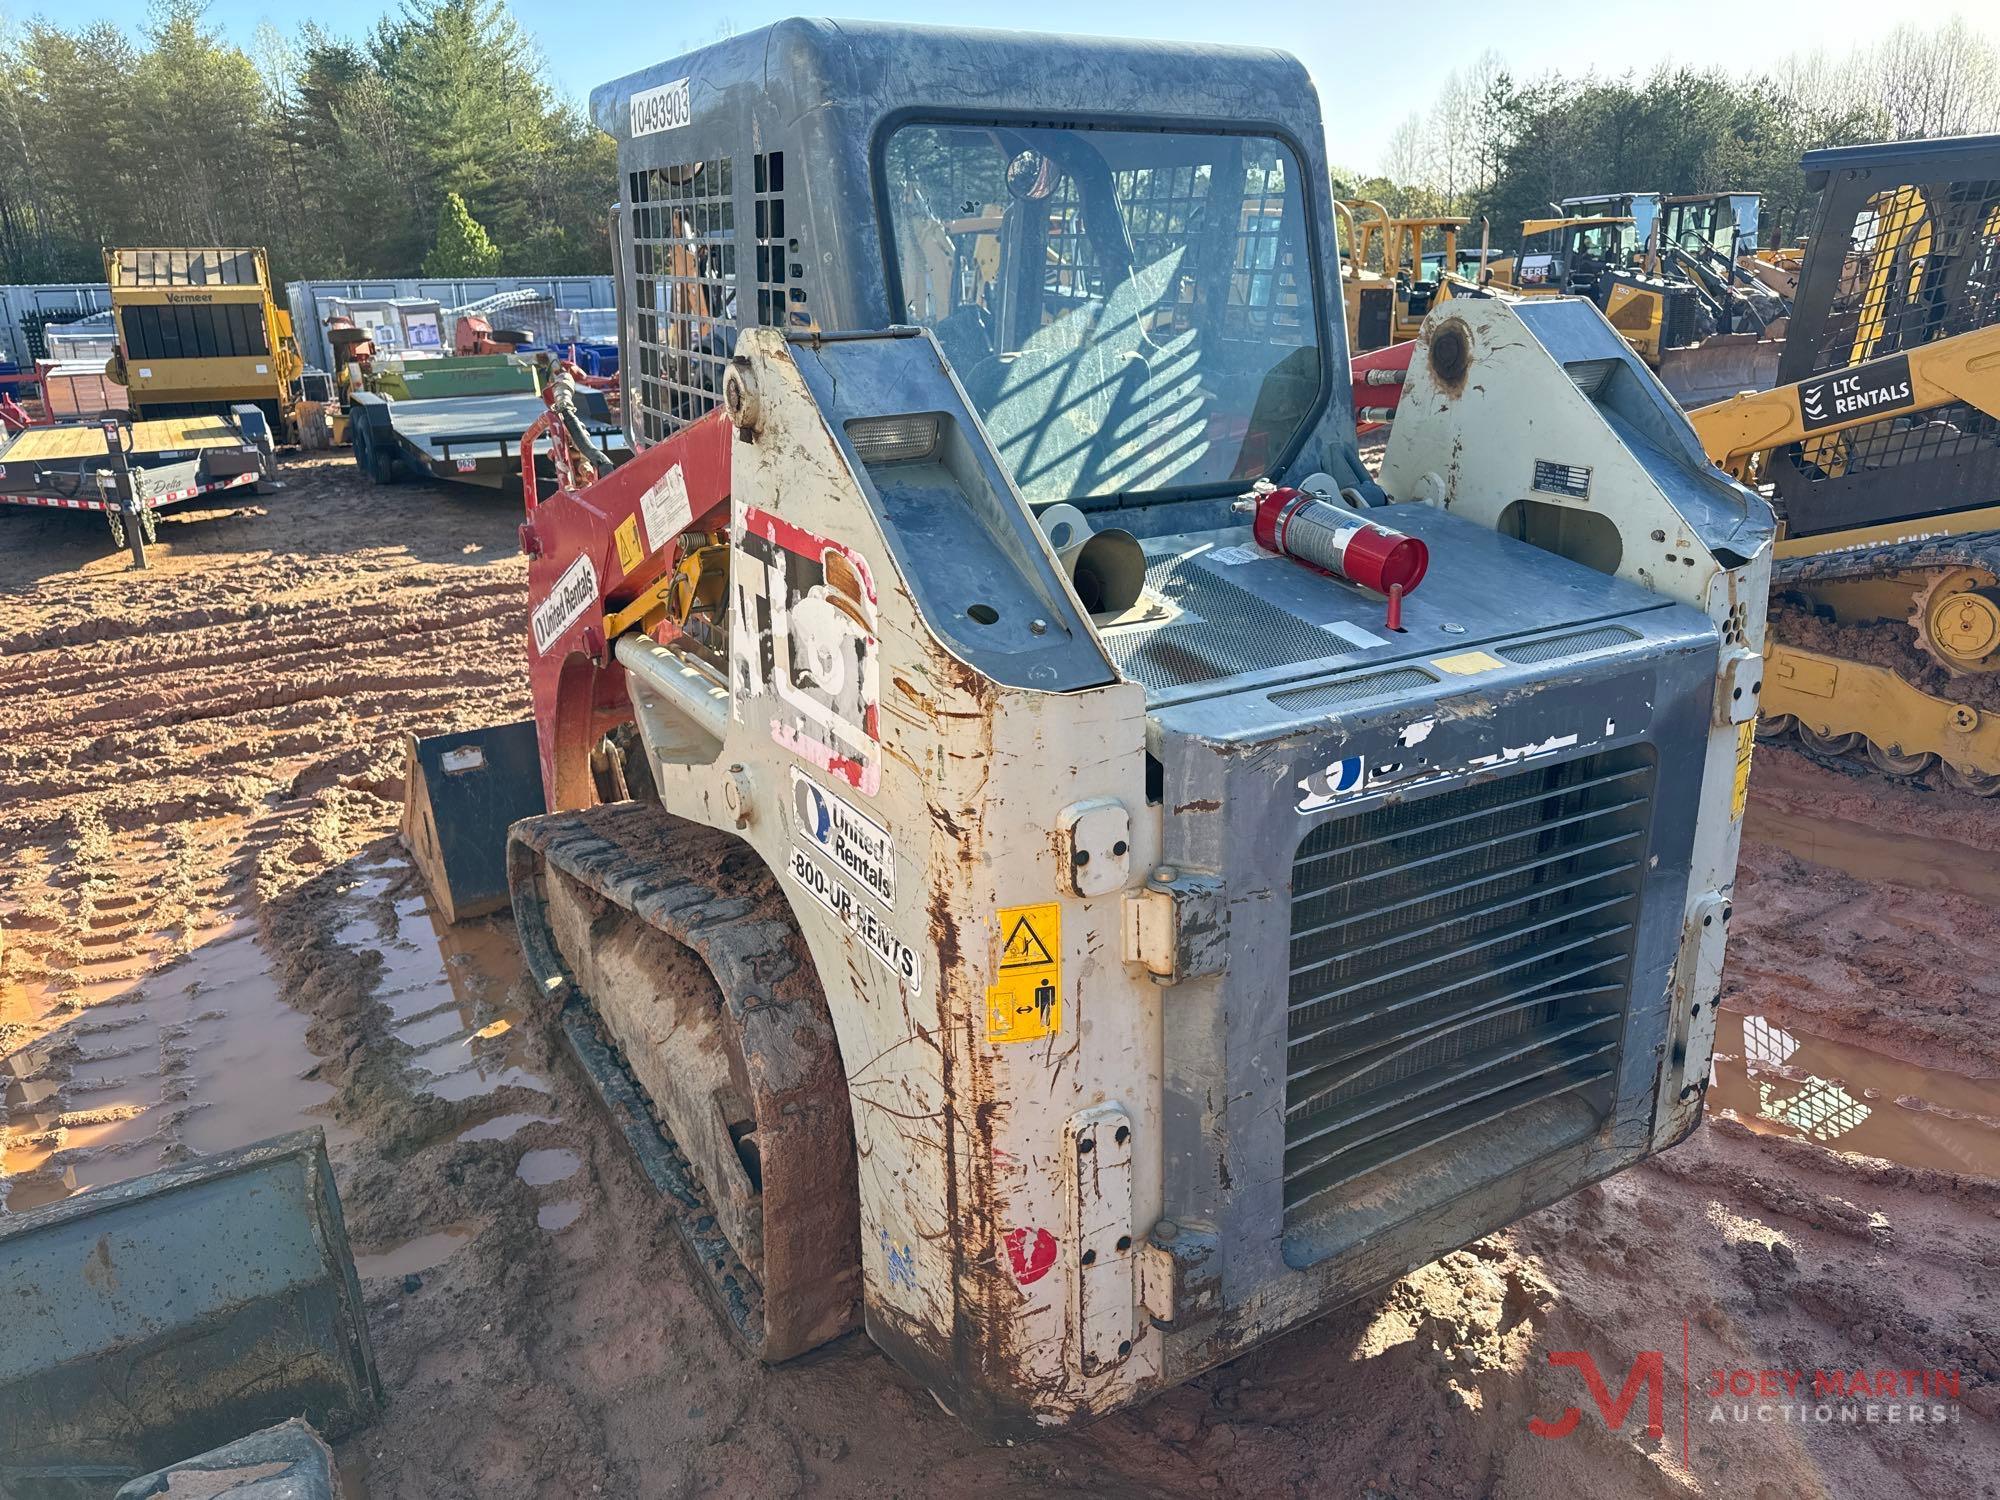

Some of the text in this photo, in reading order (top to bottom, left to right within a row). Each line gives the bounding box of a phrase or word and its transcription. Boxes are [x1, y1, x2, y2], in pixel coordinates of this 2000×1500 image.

[632, 88, 689, 134] 10493903
[1521, 267, 1549, 276] EERE
[165, 293, 213, 303] Vermeer
[1833, 375, 1861, 396] LTC
[1835, 381, 1910, 414] RENTALS
[153, 476, 182, 493] Delta
[543, 566, 594, 638] United Rentals
[832, 803, 884, 865] United
[835, 834, 891, 899] Rentals
